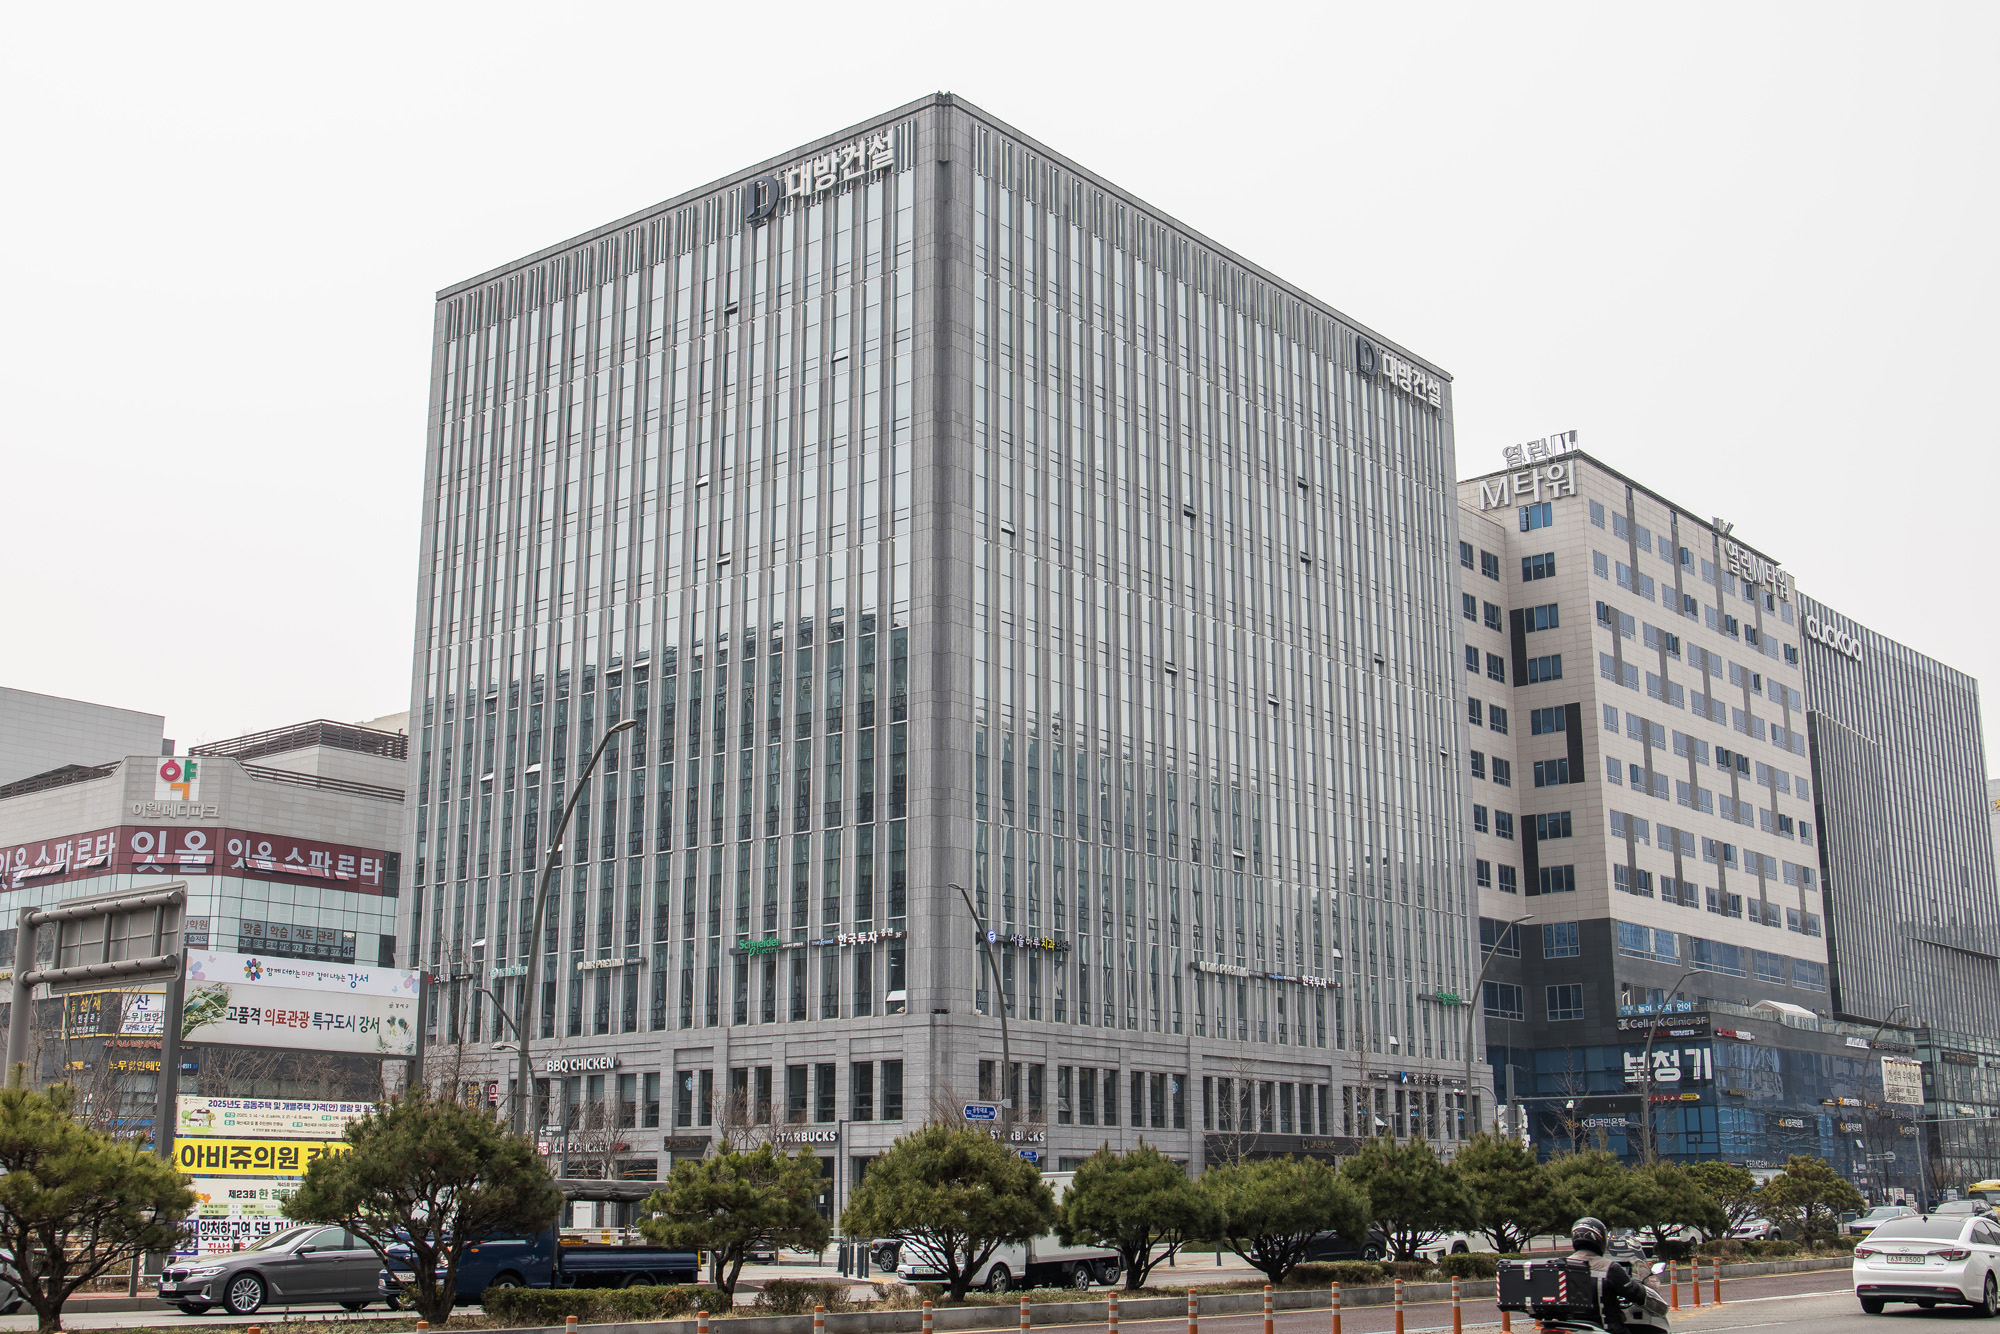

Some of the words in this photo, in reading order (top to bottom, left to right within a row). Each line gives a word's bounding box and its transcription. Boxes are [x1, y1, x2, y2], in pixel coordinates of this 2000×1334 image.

[786, 126, 895, 197] 대방건설
[1382, 353, 1442, 409] 대방건설
[1502, 438, 1547, 469] 열린
[1480, 460, 1577, 511] M타워
[1725, 540, 1790, 603] 열린M타워
[0, 847, 29, 890] 잇올
[35, 832, 116, 875] 스파르타
[131, 830, 214, 873] 잇올
[228, 838, 277, 875] 잇올
[285, 847, 383, 885] 스파르타
[244, 922, 262, 936] 맞춤
[270, 925, 289, 939] 학습
[296, 928, 314, 940] 지도
[317, 931, 335, 943] 관리
[739, 936, 781, 949] Schneider
[838, 930, 878, 947] 한국투자
[348, 973, 369, 989] 강서
[1638, 1004, 1652, 1014] 놀이
[1676, 1002, 1692, 1012] 언어
[226, 1006, 261, 1026] 고품격
[264, 1008, 310, 1029] 의료관광
[312, 1011, 356, 1032] 특구도시
[359, 1015, 380, 1034] 강서
[1658, 1018, 1666, 1027] K
[1666, 1016, 1692, 1026] Clinic
[1695, 1016, 1706, 1025] 3F
[547, 1060, 569, 1073] BBQ
[570, 1056, 614, 1070] CHICKEN
[1623, 1047, 1713, 1083] 보청기
[208, 1099, 241, 1109] 2025년도
[243, 1100, 271, 1110] 공동주택
[274, 1102, 281, 1110] 및
[282, 1102, 311, 1111] 개별주택
[312, 1103, 338, 1112] 가격(안)
[1581, 1118, 1626, 1128] KB국민은행
[775, 1131, 837, 1143] STARBUCKS
[990, 1130, 1045, 1142] STRBUCKS
[181, 1144, 299, 1170] 아비쥬의원
[228, 1189, 257, 1199] 제23회
[259, 1188, 268, 1200] 한
[200, 1221, 250, 1241] 양천향교역
